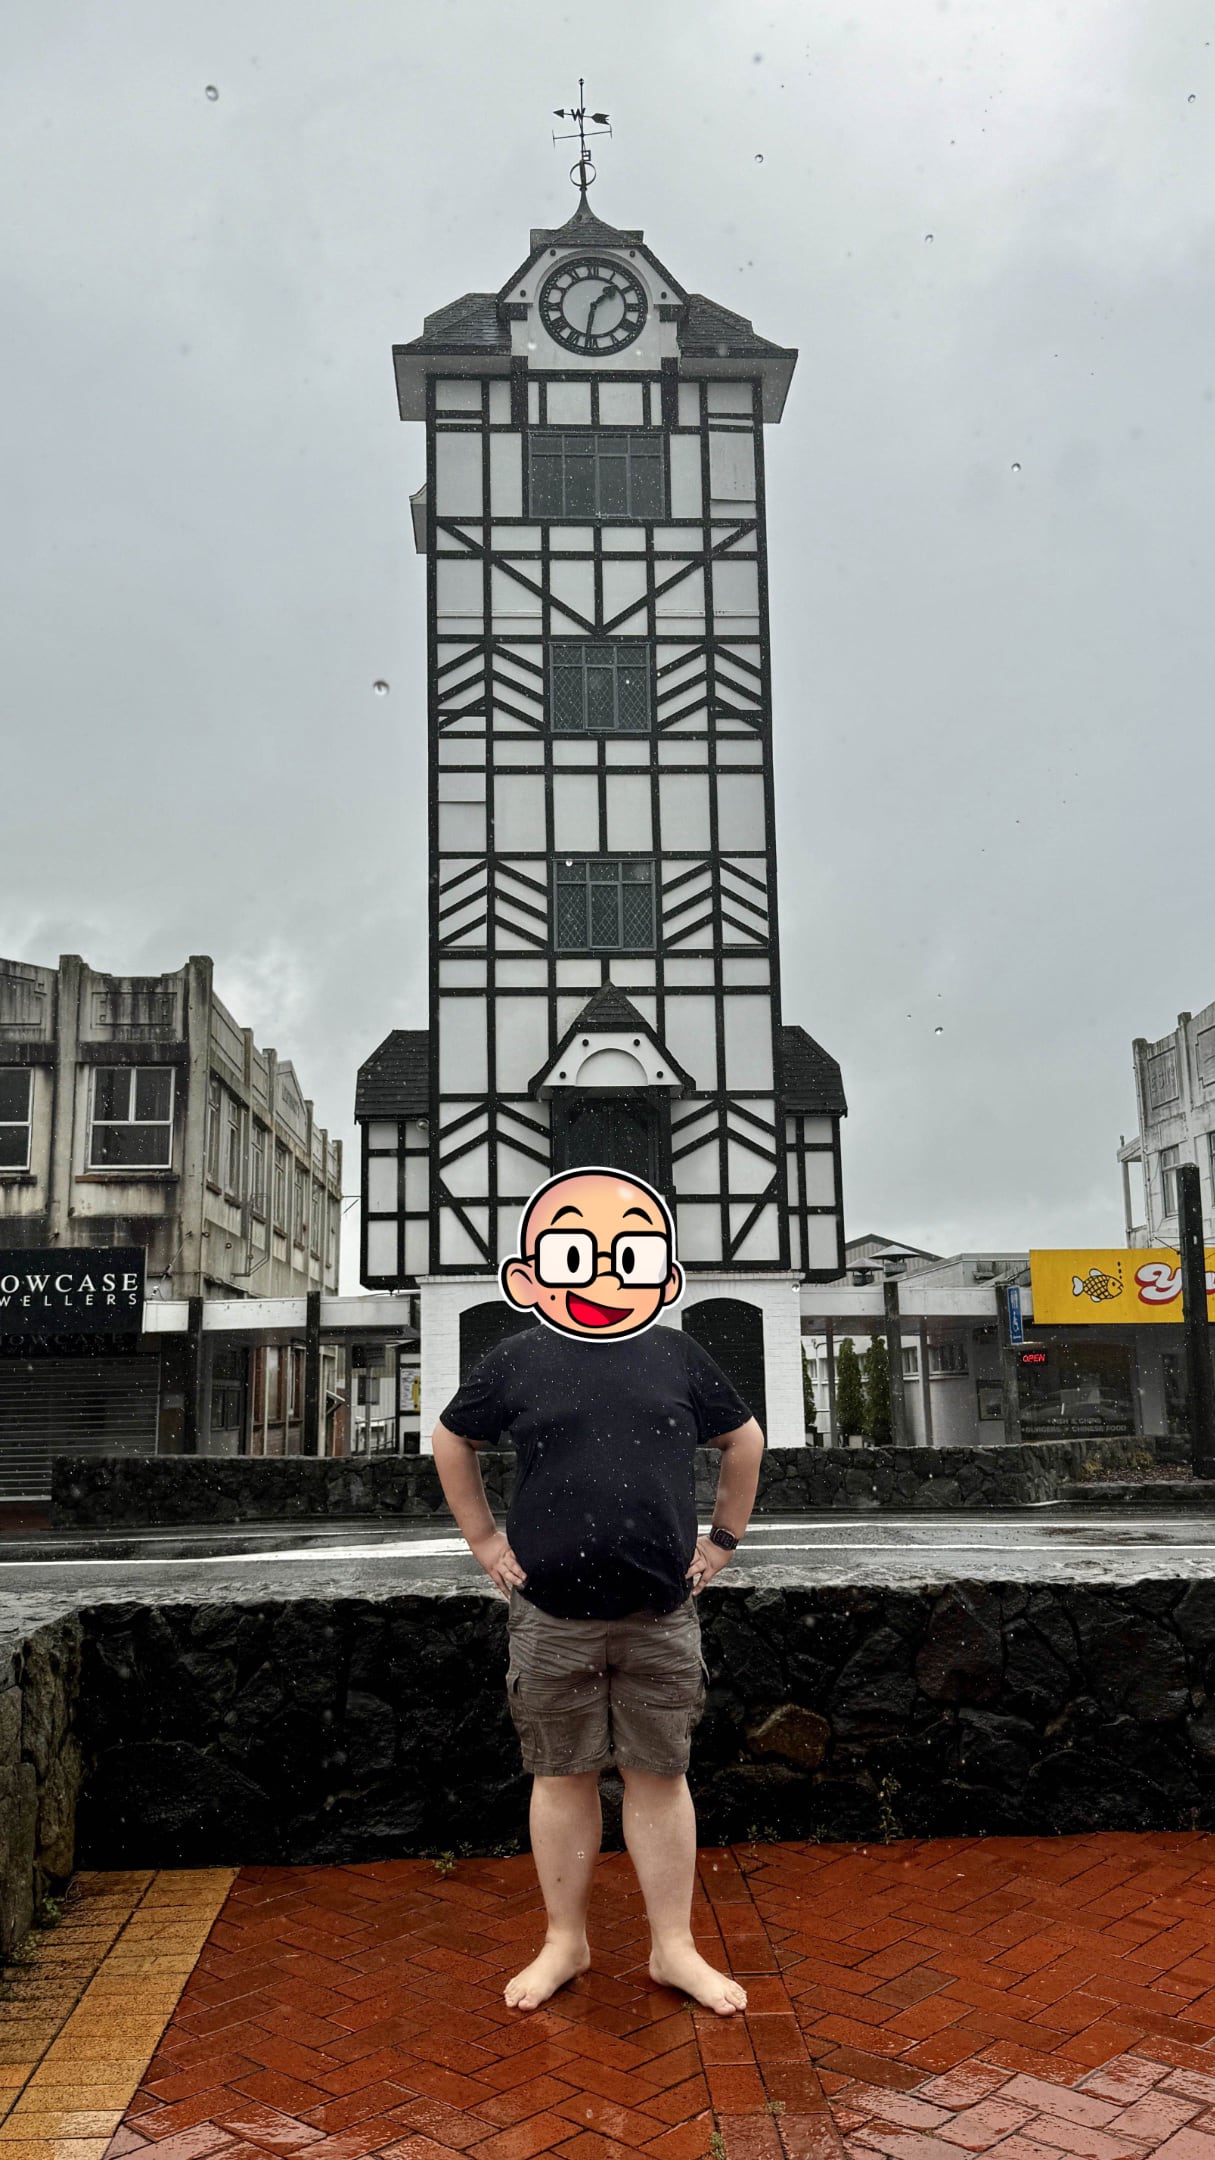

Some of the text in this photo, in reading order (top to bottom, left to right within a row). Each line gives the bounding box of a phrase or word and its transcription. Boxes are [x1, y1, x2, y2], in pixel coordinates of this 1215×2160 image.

[570, 107, 586, 122] W
[0, 1273, 138, 1293] OWCASE
[0, 1293, 137, 1307] WELLERS
[1023, 1353, 1046, 1363] OPEN
[1105, 1424, 1127, 1432] FOOD
